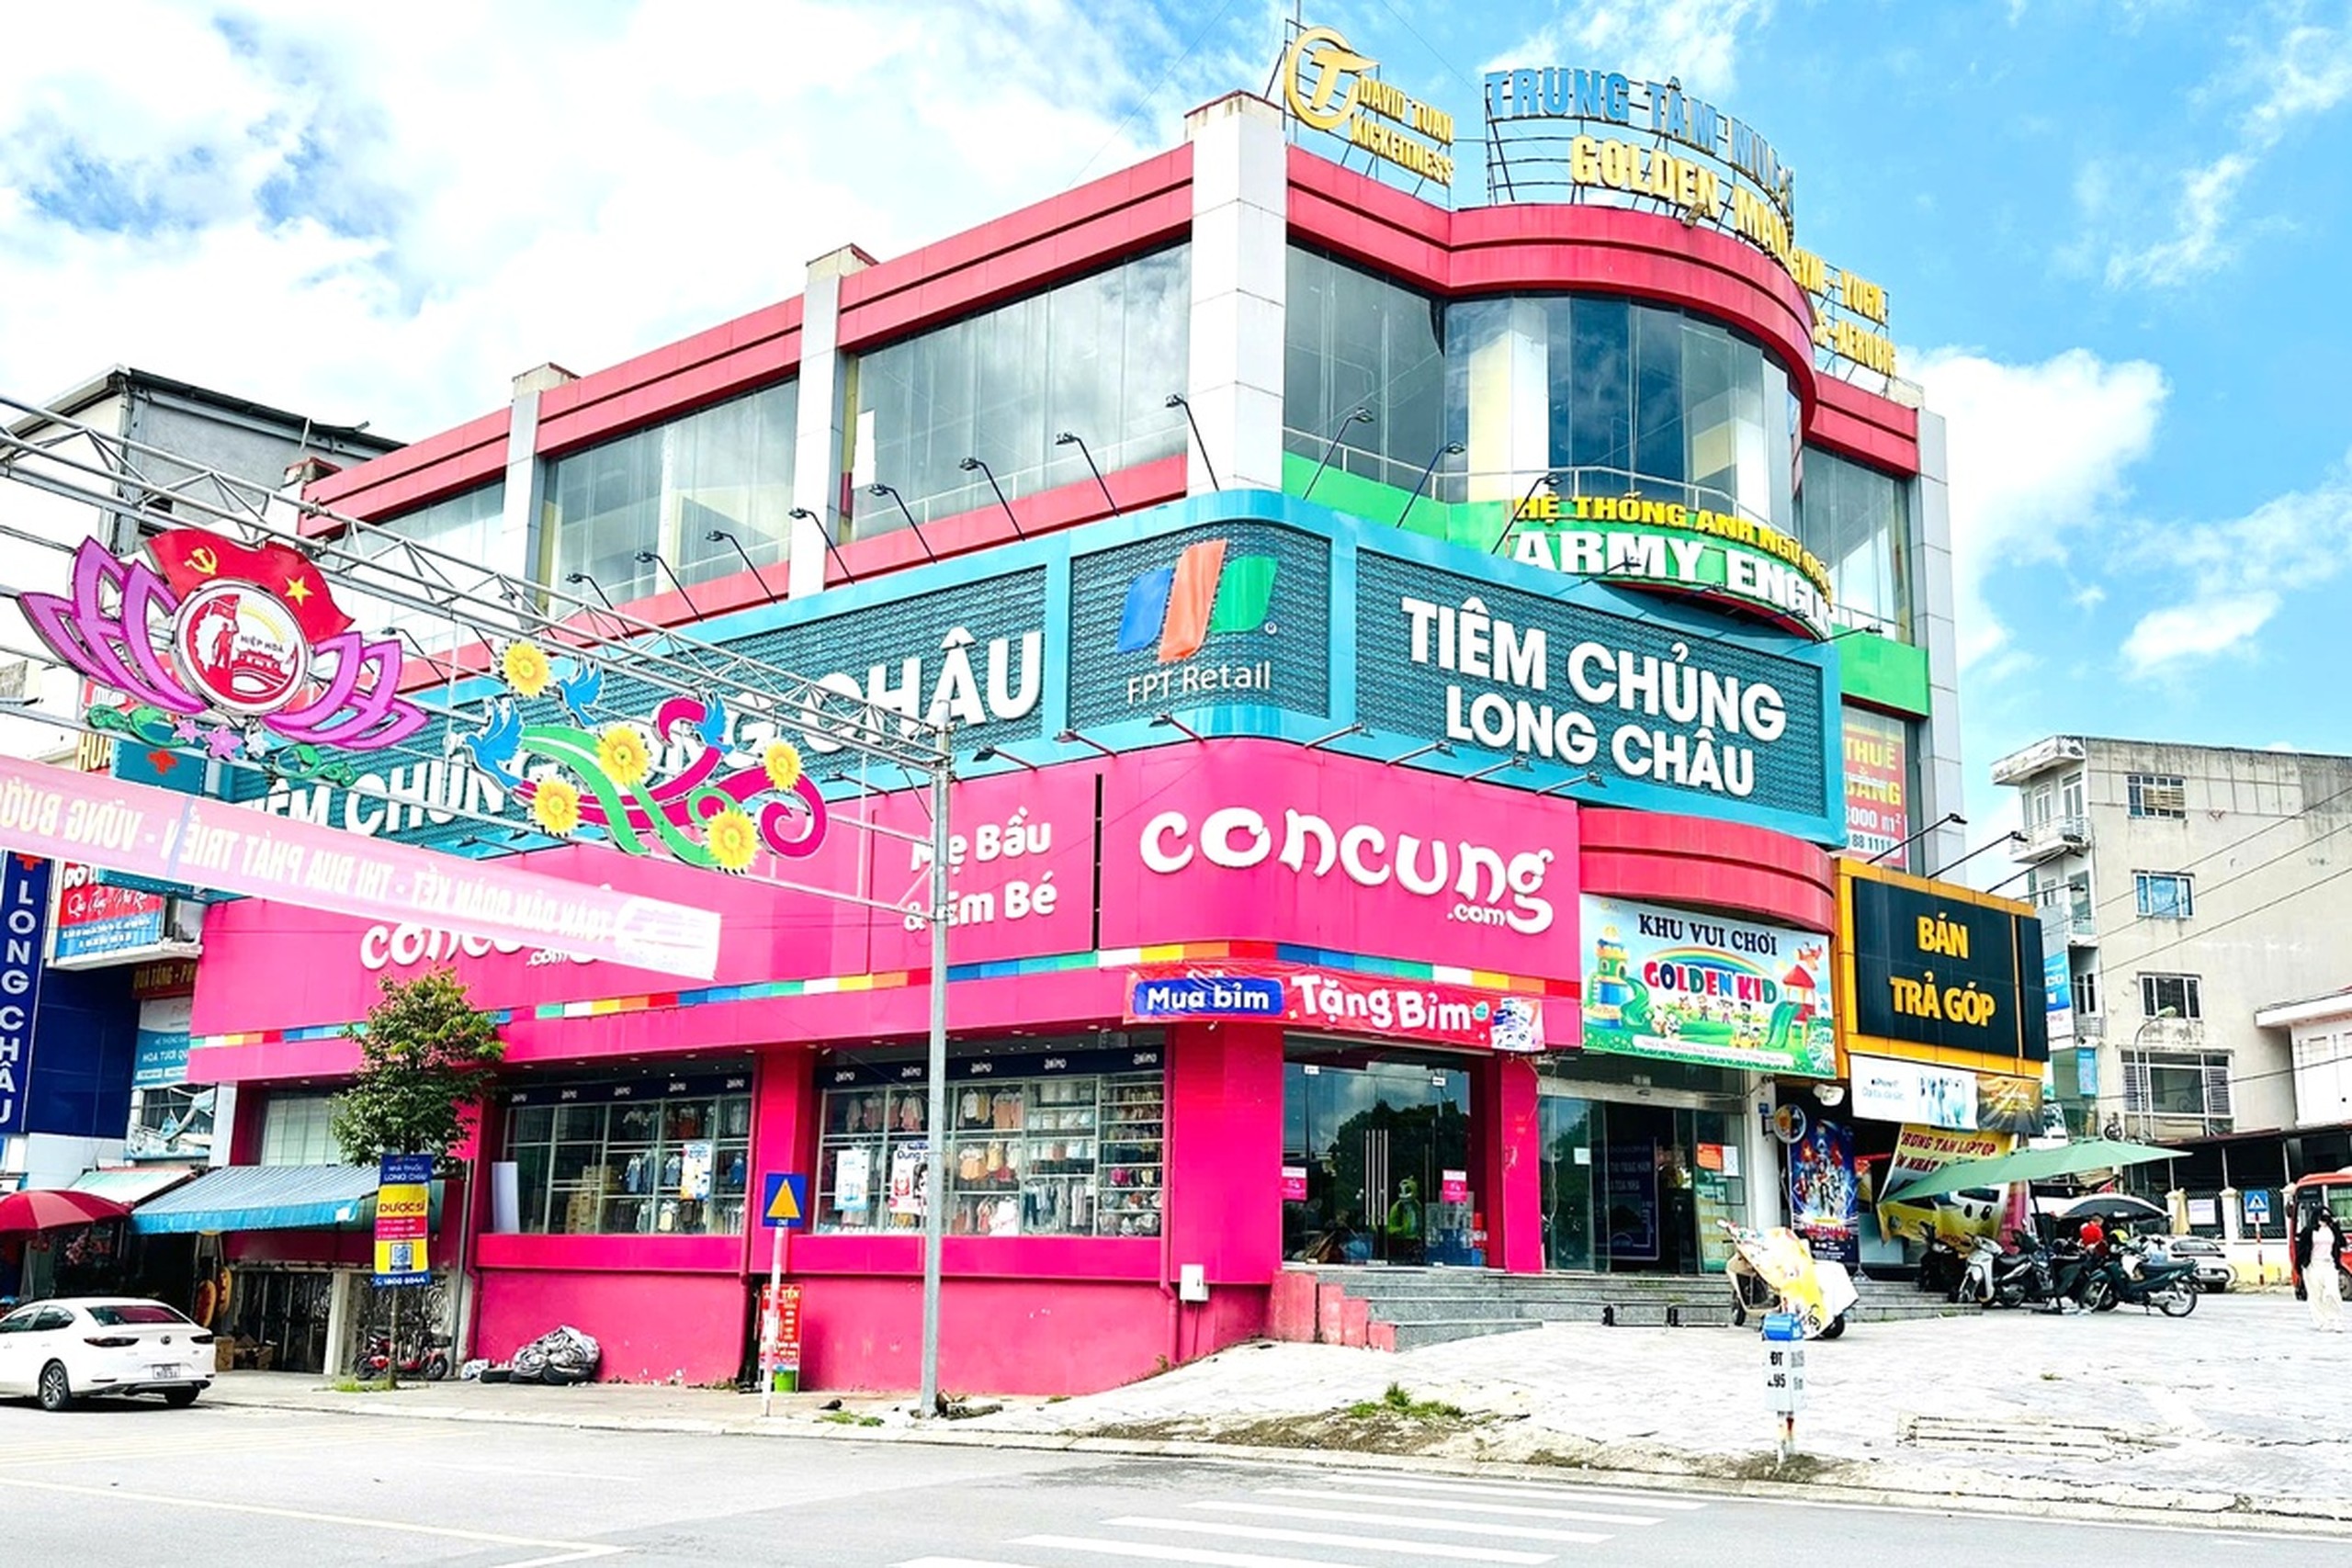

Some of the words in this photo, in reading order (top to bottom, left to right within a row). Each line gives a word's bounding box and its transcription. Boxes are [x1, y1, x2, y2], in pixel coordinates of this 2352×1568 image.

[1357, 75, 1407, 122] DAVID
[1485, 67, 1630, 125] TRUNG
[1645, 76, 1718, 156] TÂM
[1569, 134, 1720, 219] GOLDEN
[1515, 491, 1559, 526] HỆ
[1573, 491, 1687, 526] THỐNG
[1696, 513, 1757, 543] ANH
[1514, 529, 1706, 583] ARMY
[803, 626, 1044, 753] CHÂU
[1127, 671, 1173, 704] FPT
[1182, 660, 1272, 694] Retail
[1400, 596, 1547, 692] TIÊM
[1567, 642, 1787, 742] CHỦNG
[1445, 684, 1598, 764] LONG
[1611, 725, 1754, 797] CHÂU
[976, 807, 1052, 862] Bầu
[1004, 871, 1057, 919] Bé
[1139, 806, 1555, 934] concung
[1, 879, 37, 996] LONG
[1639, 914, 1683, 940] KHU
[1690, 922, 1725, 948] VUI
[1731, 930, 1778, 956] CHƠI
[1917, 911, 1969, 959] BÁN
[1147, 987, 1209, 1011] Mua
[1214, 981, 1269, 1010] bỉm
[1290, 974, 1393, 1029] Tặng
[1395, 989, 1472, 1031] Bỉm
[1643, 961, 1734, 998] GOLDEN
[1737, 975, 1778, 1004] KID
[1889, 970, 1942, 1020] TRẢ
[1943, 981, 1996, 1027] GÓP
